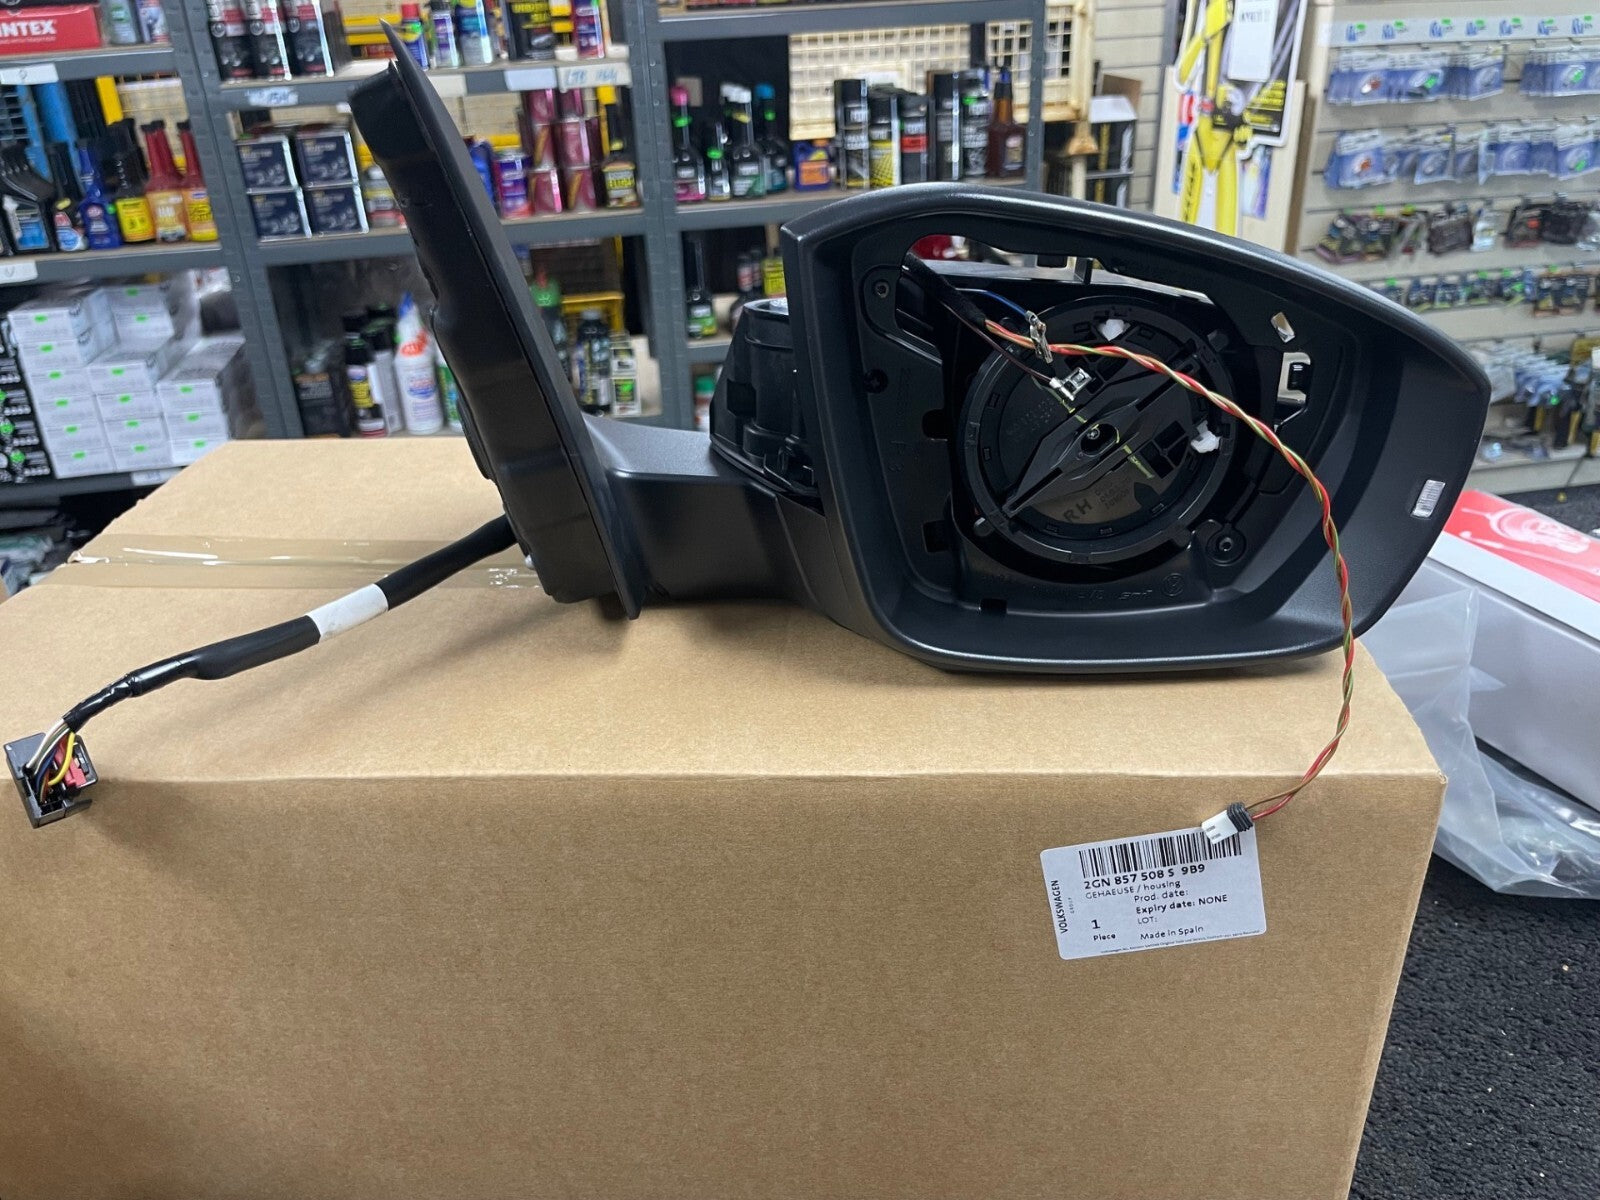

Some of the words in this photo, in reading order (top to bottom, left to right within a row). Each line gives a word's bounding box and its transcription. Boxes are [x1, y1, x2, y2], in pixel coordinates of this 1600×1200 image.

[1084, 877, 1111, 890] 2GN
[1114, 873, 1137, 885] 857
[1141, 870, 1165, 881] 508
[1181, 863, 1206, 876] 9B9
[1085, 886, 1135, 900] GEHAEUSE
[1143, 880, 1181, 891] housing
[1162, 890, 1189, 899] date:
[1051, 879, 1068, 934] VOLKSWAGEN
[1136, 903, 1167, 915] Expiry
[1169, 901, 1196, 910] date:
[1198, 894, 1228, 906] NONE
[1091, 919, 1101, 930] 1
[1138, 916, 1158, 925] LOT:
[1093, 934, 1116, 942] Piece
[1140, 931, 1166, 941] Made
[1168, 929, 1176, 937] in
[1178, 925, 1204, 937] Spain
